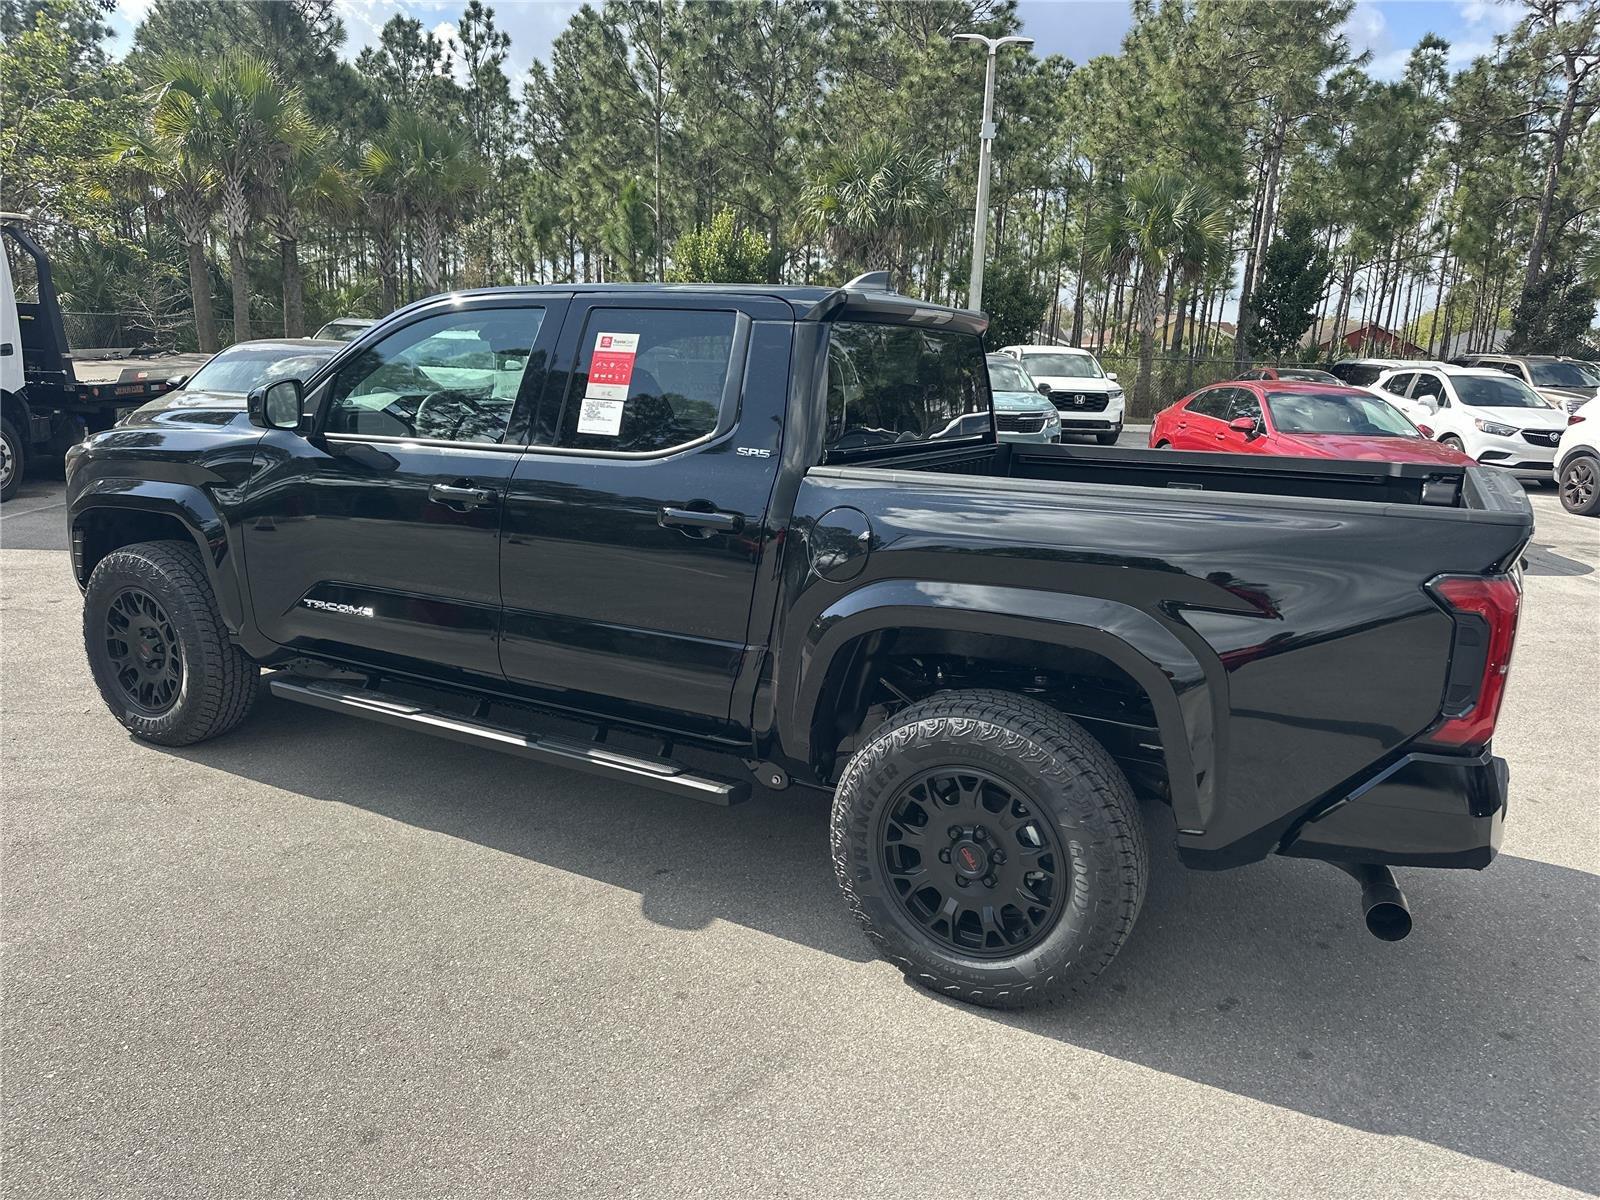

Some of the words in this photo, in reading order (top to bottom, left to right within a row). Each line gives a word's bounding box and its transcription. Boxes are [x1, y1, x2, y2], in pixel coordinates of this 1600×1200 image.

[736, 446, 771, 459] SR5
[303, 598, 374, 618] TACOMA
[853, 762, 899, 881] WRANGLER
